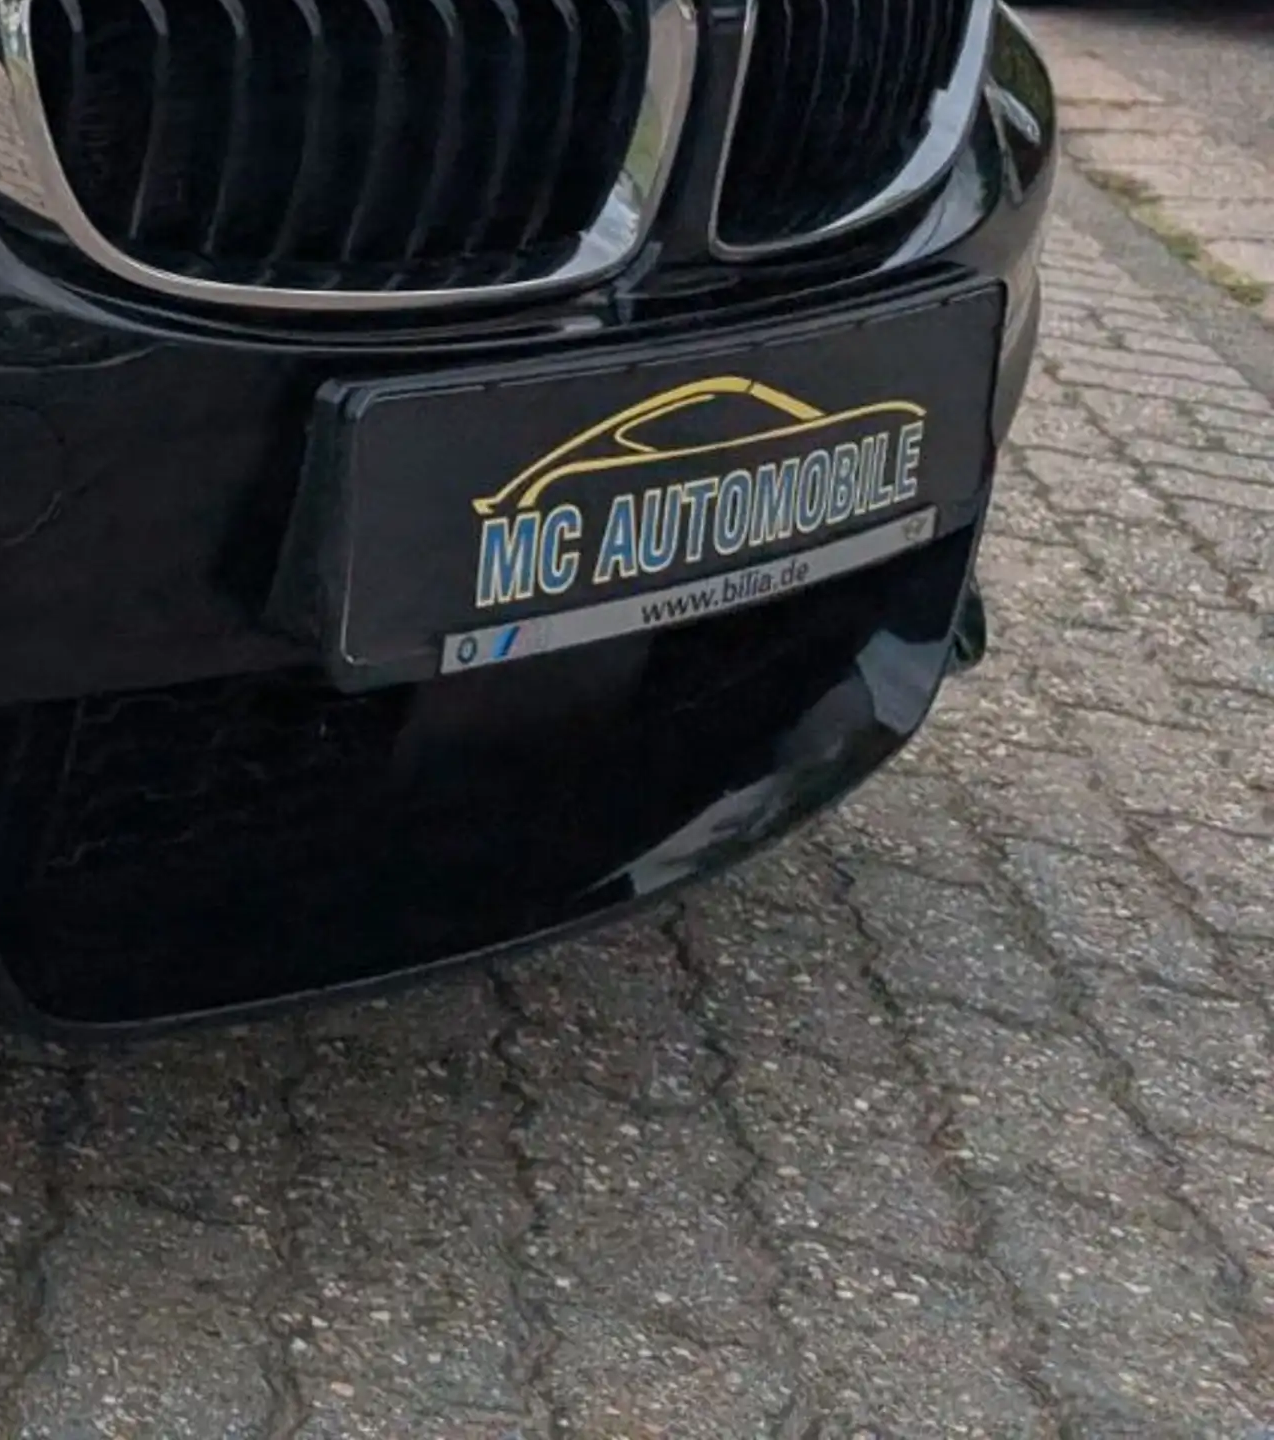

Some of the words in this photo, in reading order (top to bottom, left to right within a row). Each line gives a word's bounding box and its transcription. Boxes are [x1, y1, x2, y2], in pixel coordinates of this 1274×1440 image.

[476, 505, 583, 608] MC
[593, 420, 925, 585] AUTOMOBILE
[640, 558, 811, 626] www.bilia.de
